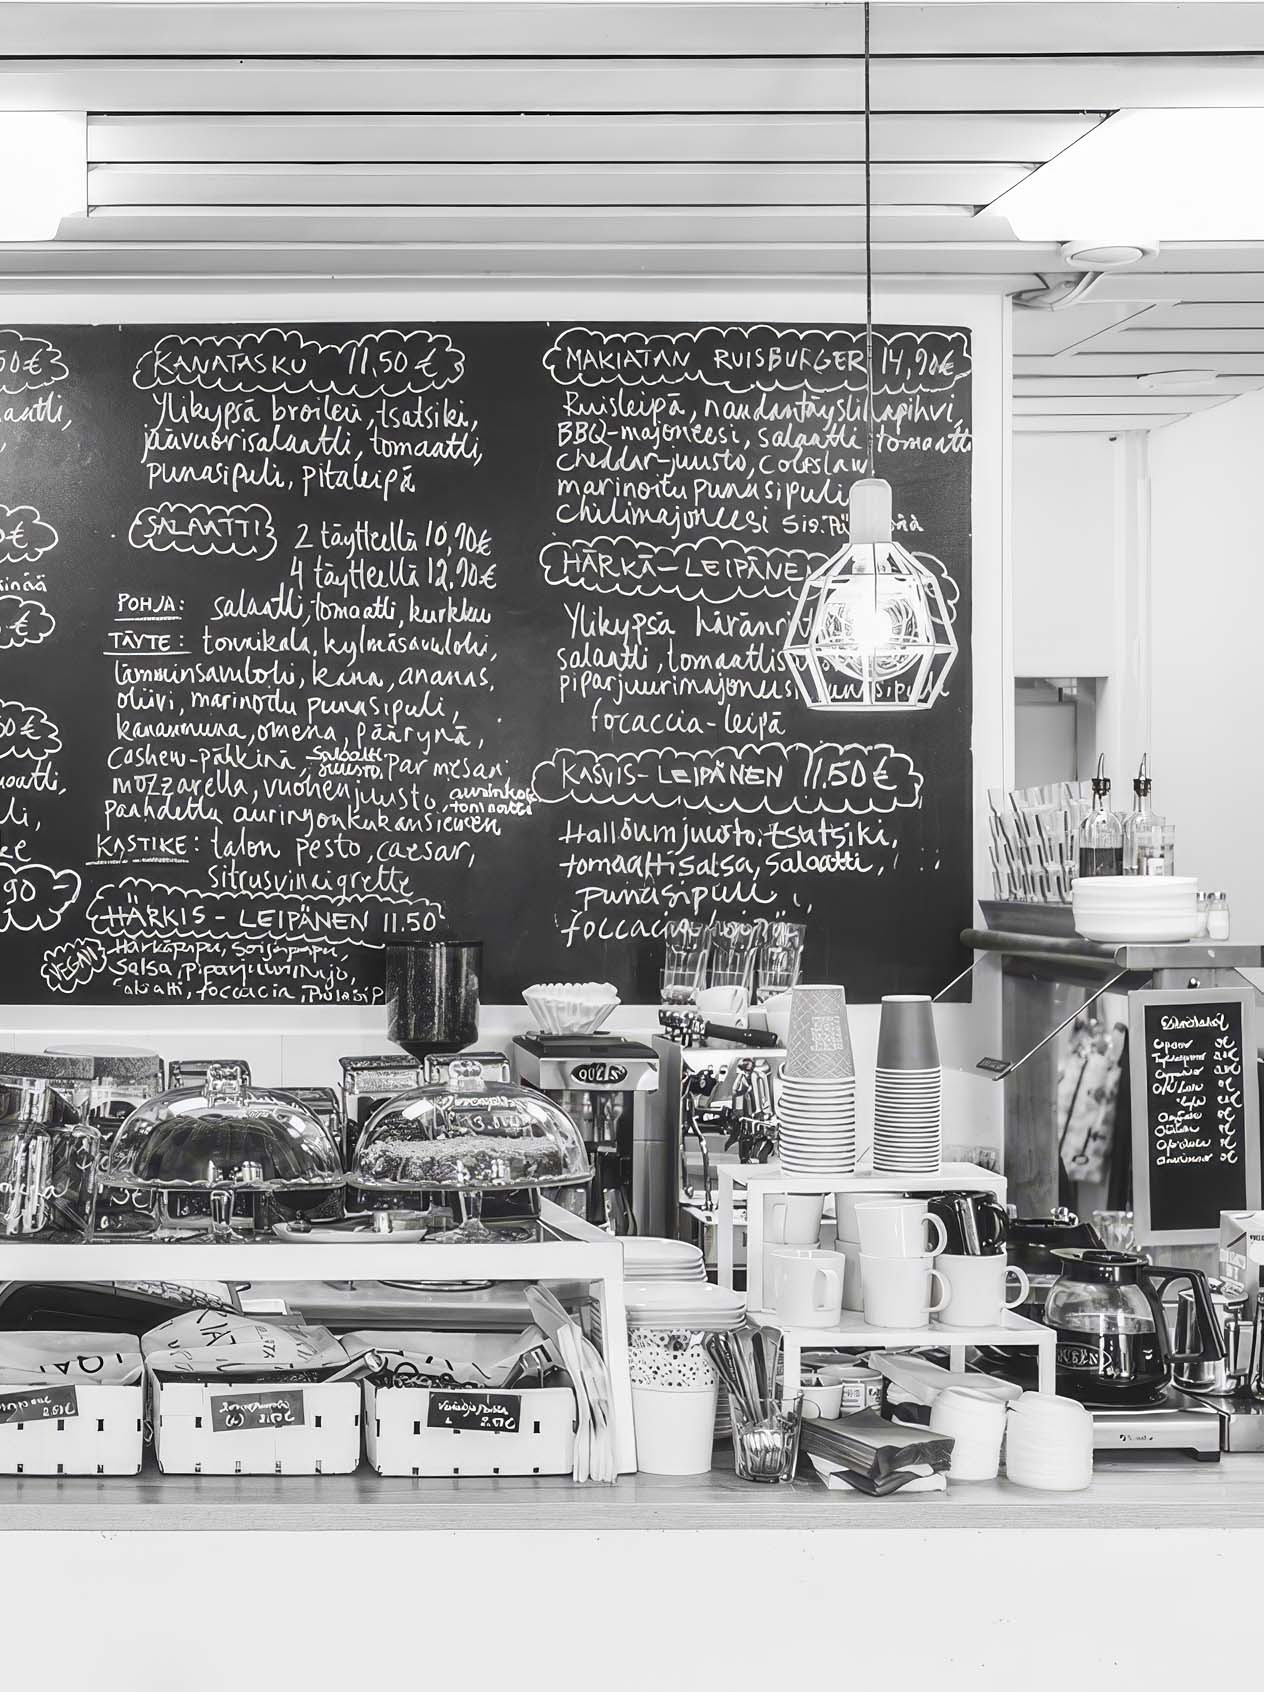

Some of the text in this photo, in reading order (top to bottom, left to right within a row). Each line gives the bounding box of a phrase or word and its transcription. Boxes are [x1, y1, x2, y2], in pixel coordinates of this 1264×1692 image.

[153, 350, 306, 378] KANATASKU
[715, 348, 867, 376] RUISBURGER
[376, 400, 478, 430] tsatsiki,
[148, 458, 416, 500] punasipuli, pitaleipä
[558, 476, 687, 500] marinoitu
[144, 516, 261, 538] SALAATTI
[295, 524, 313, 549] 2
[291, 558, 303, 590] 4
[118, 593, 185, 612] POHJA:
[408, 599, 491, 624] kurkku
[108, 631, 185, 650] TÄYTE:
[312, 657, 395, 693] kana,
[398, 666, 495, 692] ananas,
[96, 834, 200, 857] KASTIKE:
[212, 829, 281, 859] talon
